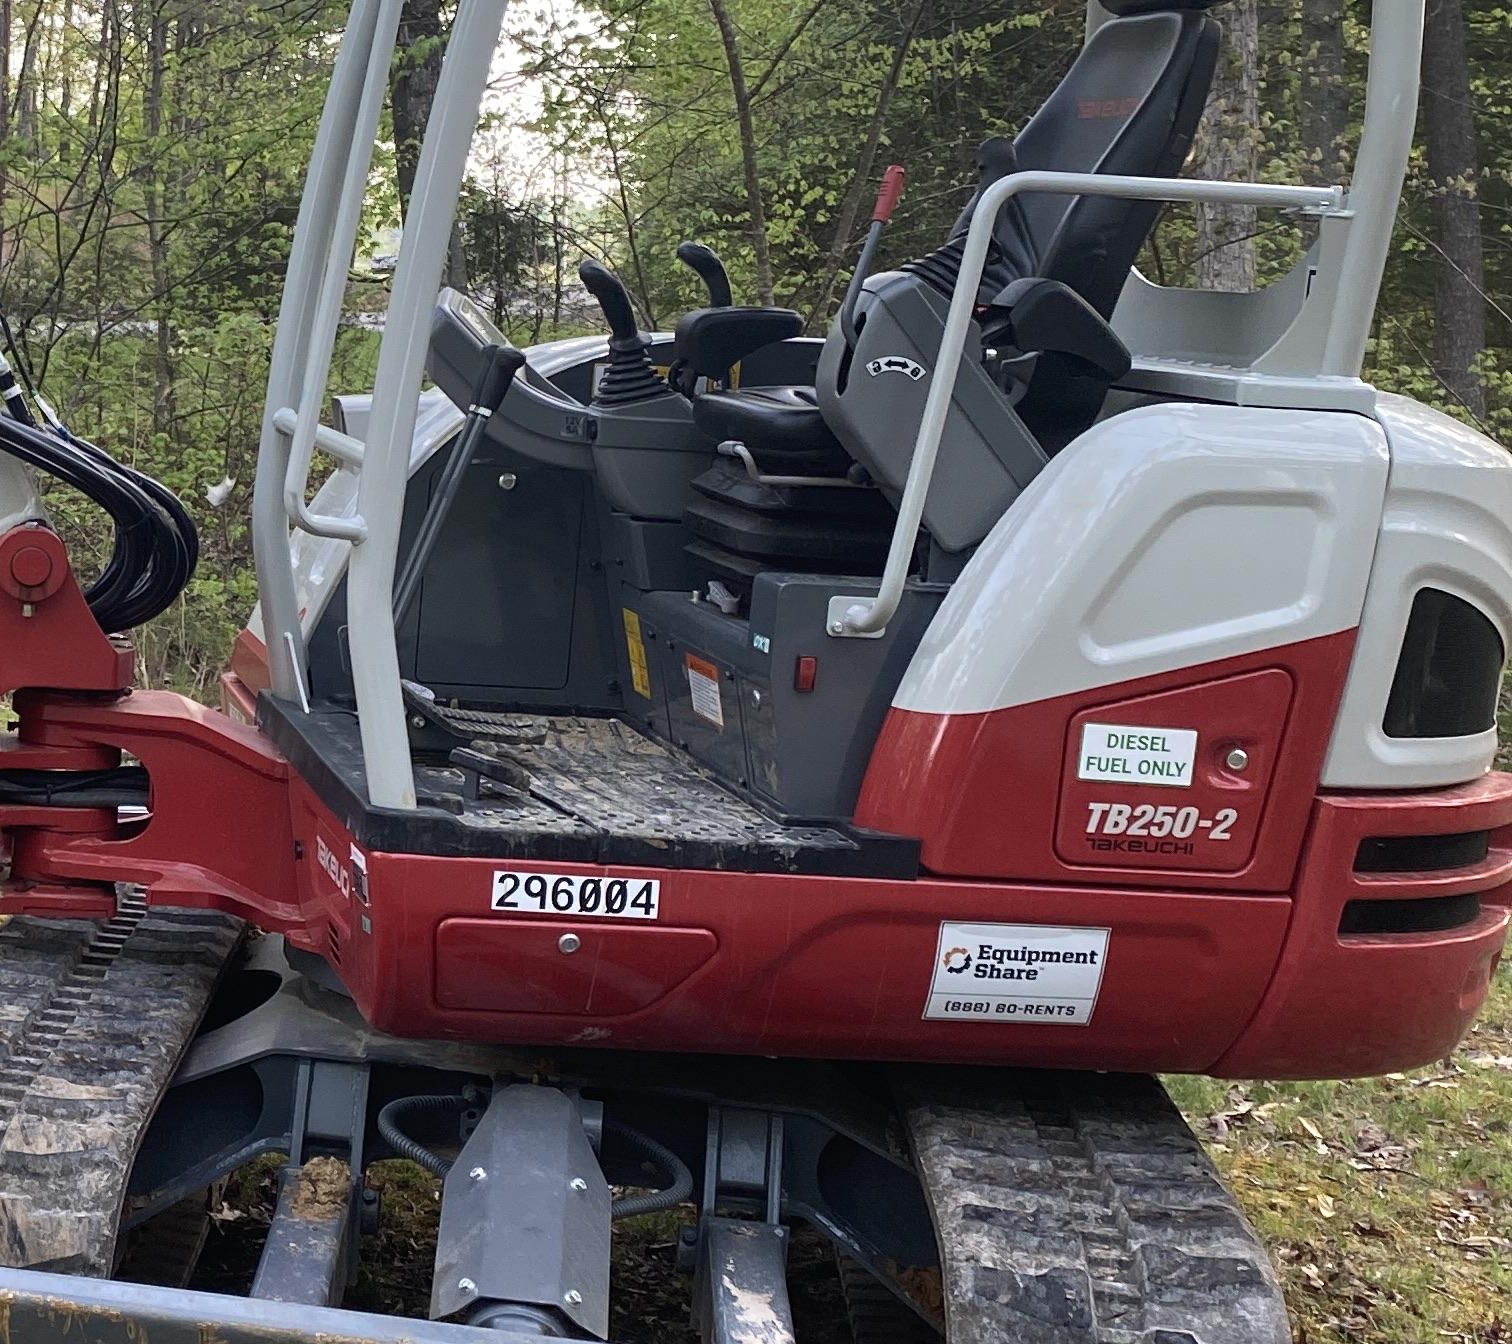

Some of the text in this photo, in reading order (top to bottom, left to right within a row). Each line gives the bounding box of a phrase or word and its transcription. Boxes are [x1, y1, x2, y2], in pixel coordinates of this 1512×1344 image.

[1106, 733, 1171, 752] DIESEL
[1085, 756, 1187, 778] FUEL ONLY
[1085, 802, 1238, 841] TB250-2
[494, 873, 656, 916] 296004
[976, 944, 1099, 966] Equipment
[944, 1000, 991, 1014] (888)
